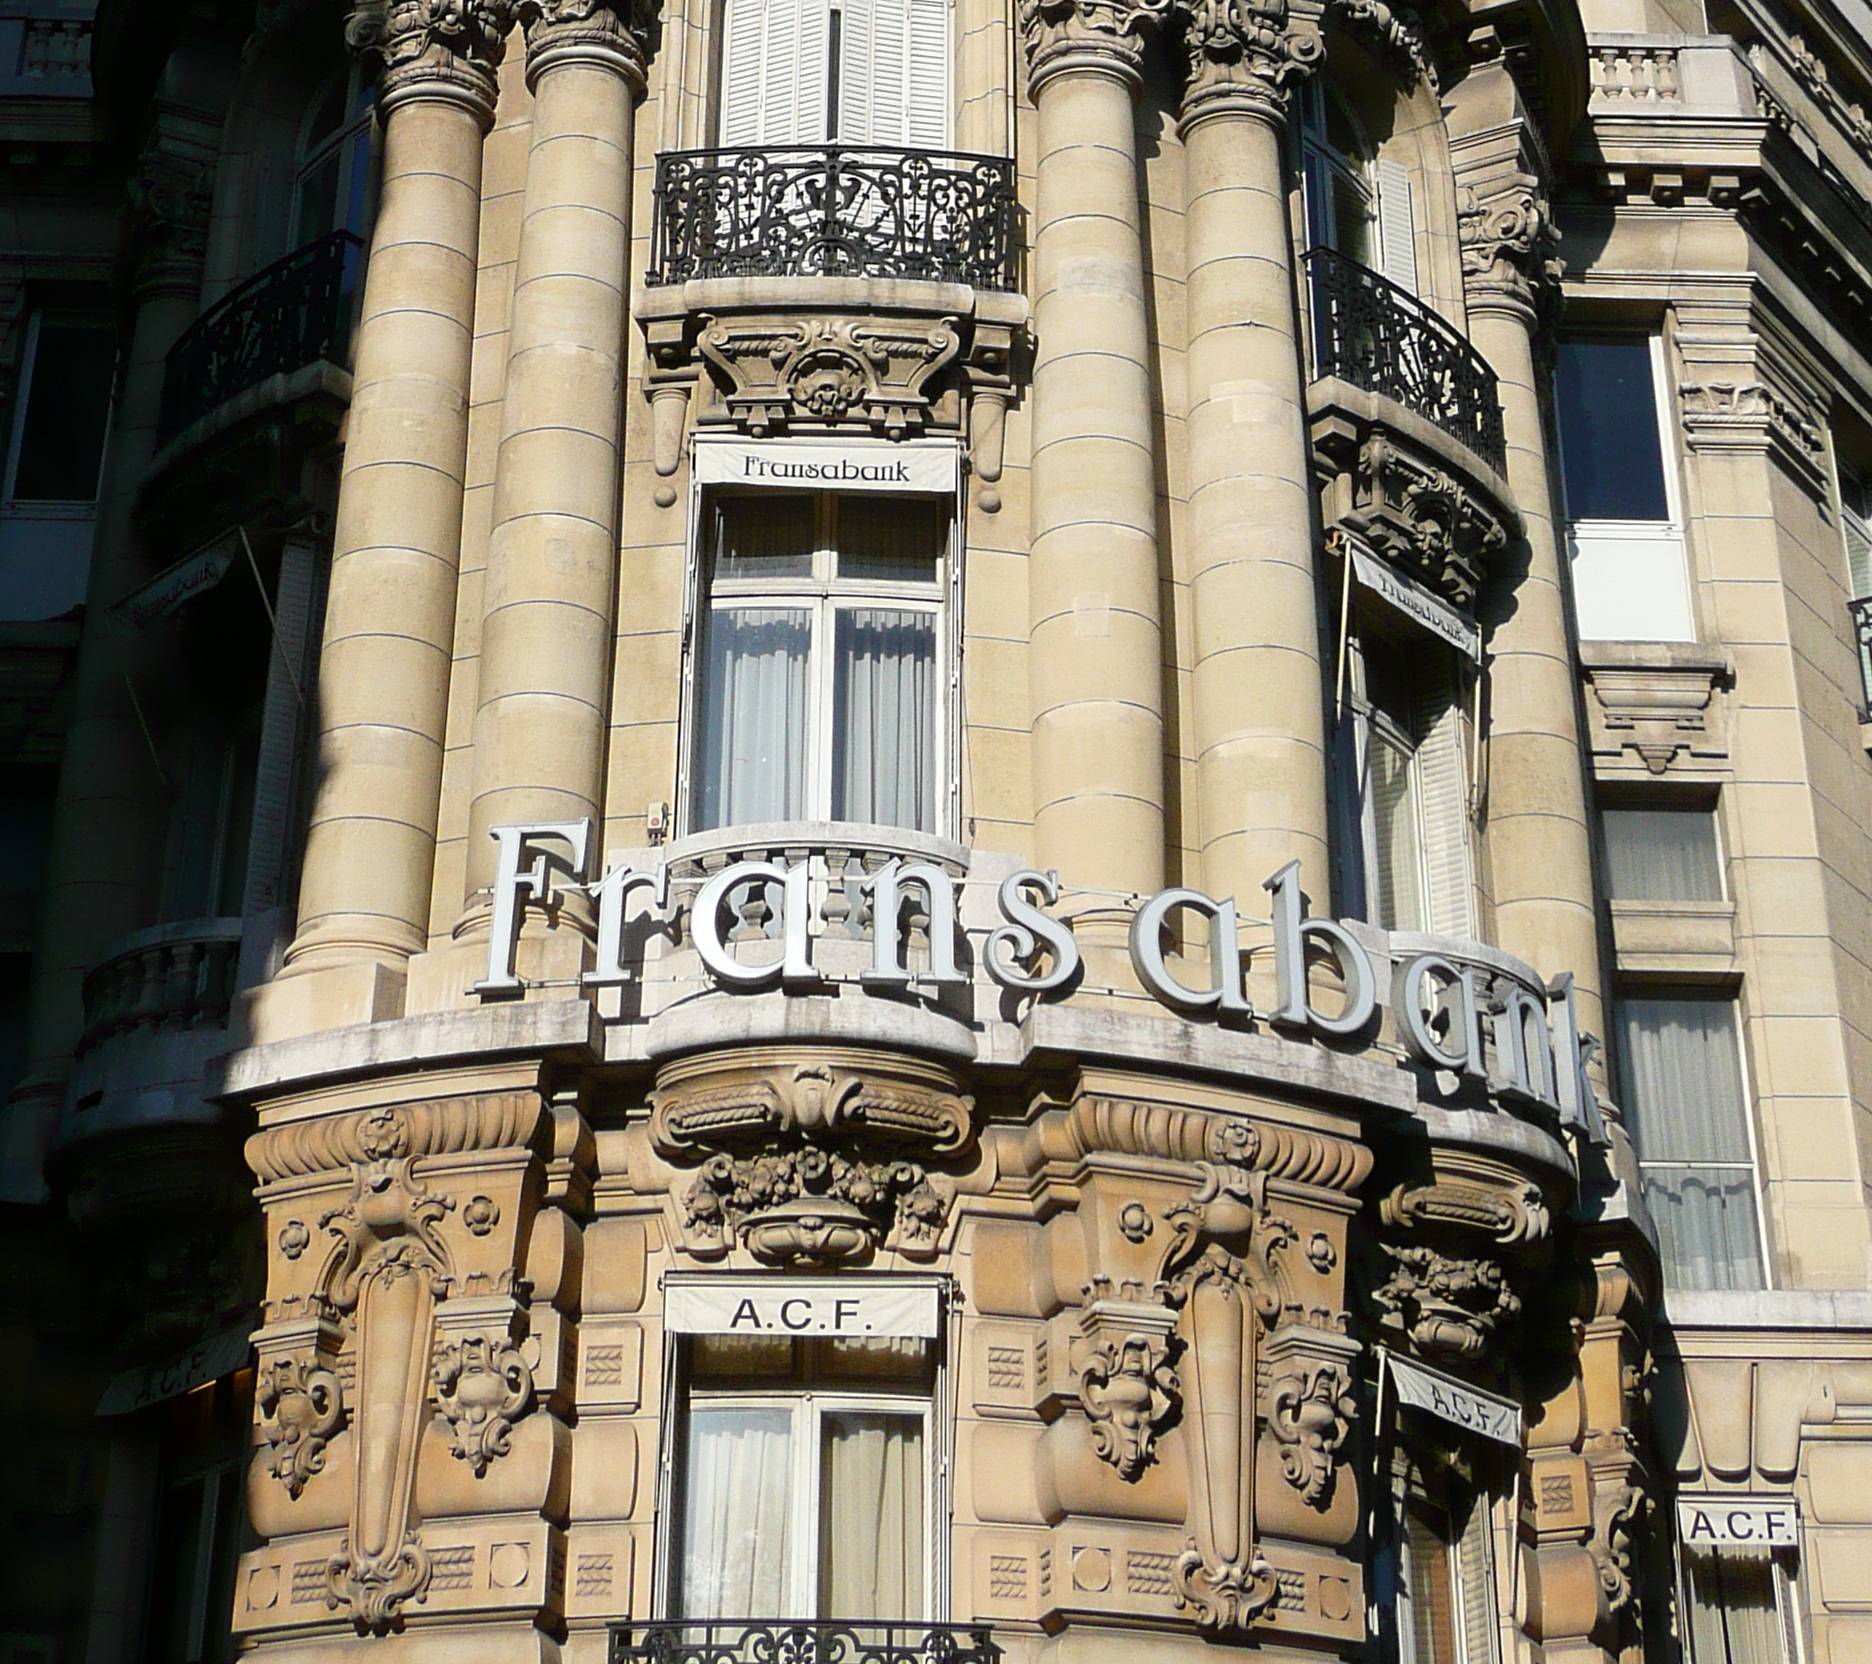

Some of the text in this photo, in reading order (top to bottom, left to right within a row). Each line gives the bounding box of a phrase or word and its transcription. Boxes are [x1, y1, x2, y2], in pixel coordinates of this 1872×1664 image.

[743, 455, 911, 483] Fransabank
[472, 817, 1613, 1149] Fransabank
[730, 1298, 873, 1331] A.C.F.
[1689, 1509, 1793, 1542] A.C.F.
